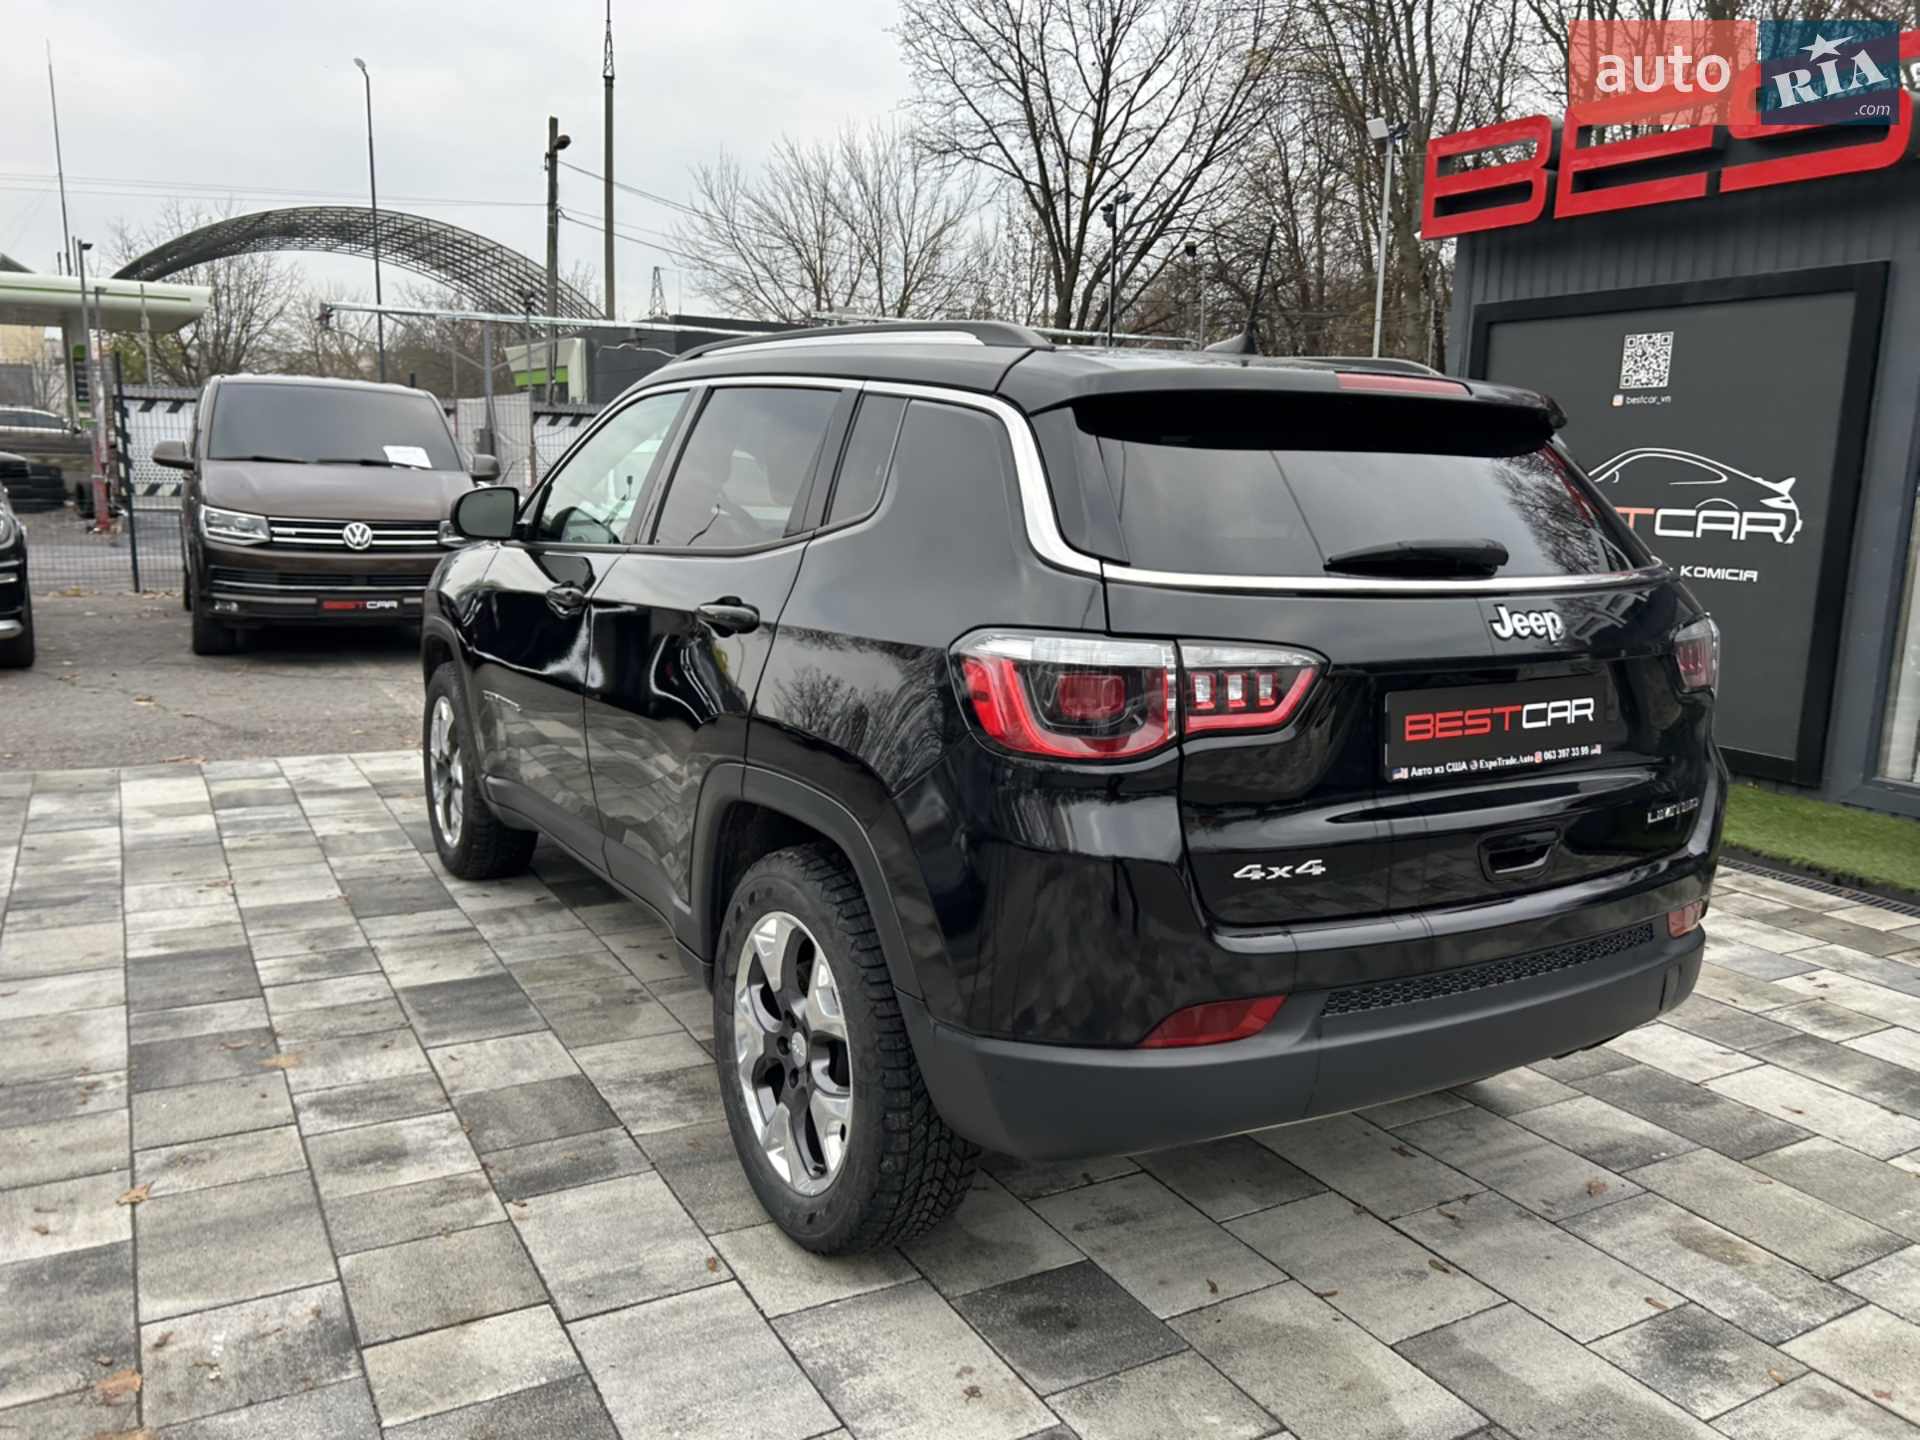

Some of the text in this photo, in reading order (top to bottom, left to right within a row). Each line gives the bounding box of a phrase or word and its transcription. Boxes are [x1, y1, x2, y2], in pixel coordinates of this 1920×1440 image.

[1625, 394, 1671, 405] bestcar_vn
[1490, 605, 1564, 642] Jeep
[1404, 697, 1595, 742] BESTCAR
[1543, 750, 1557, 761] 063
[1571, 746, 1580, 757] 33
[1580, 745, 1589, 756] 99
[1410, 761, 1468, 777] Авто из США
[1232, 859, 1327, 881] 4x4
